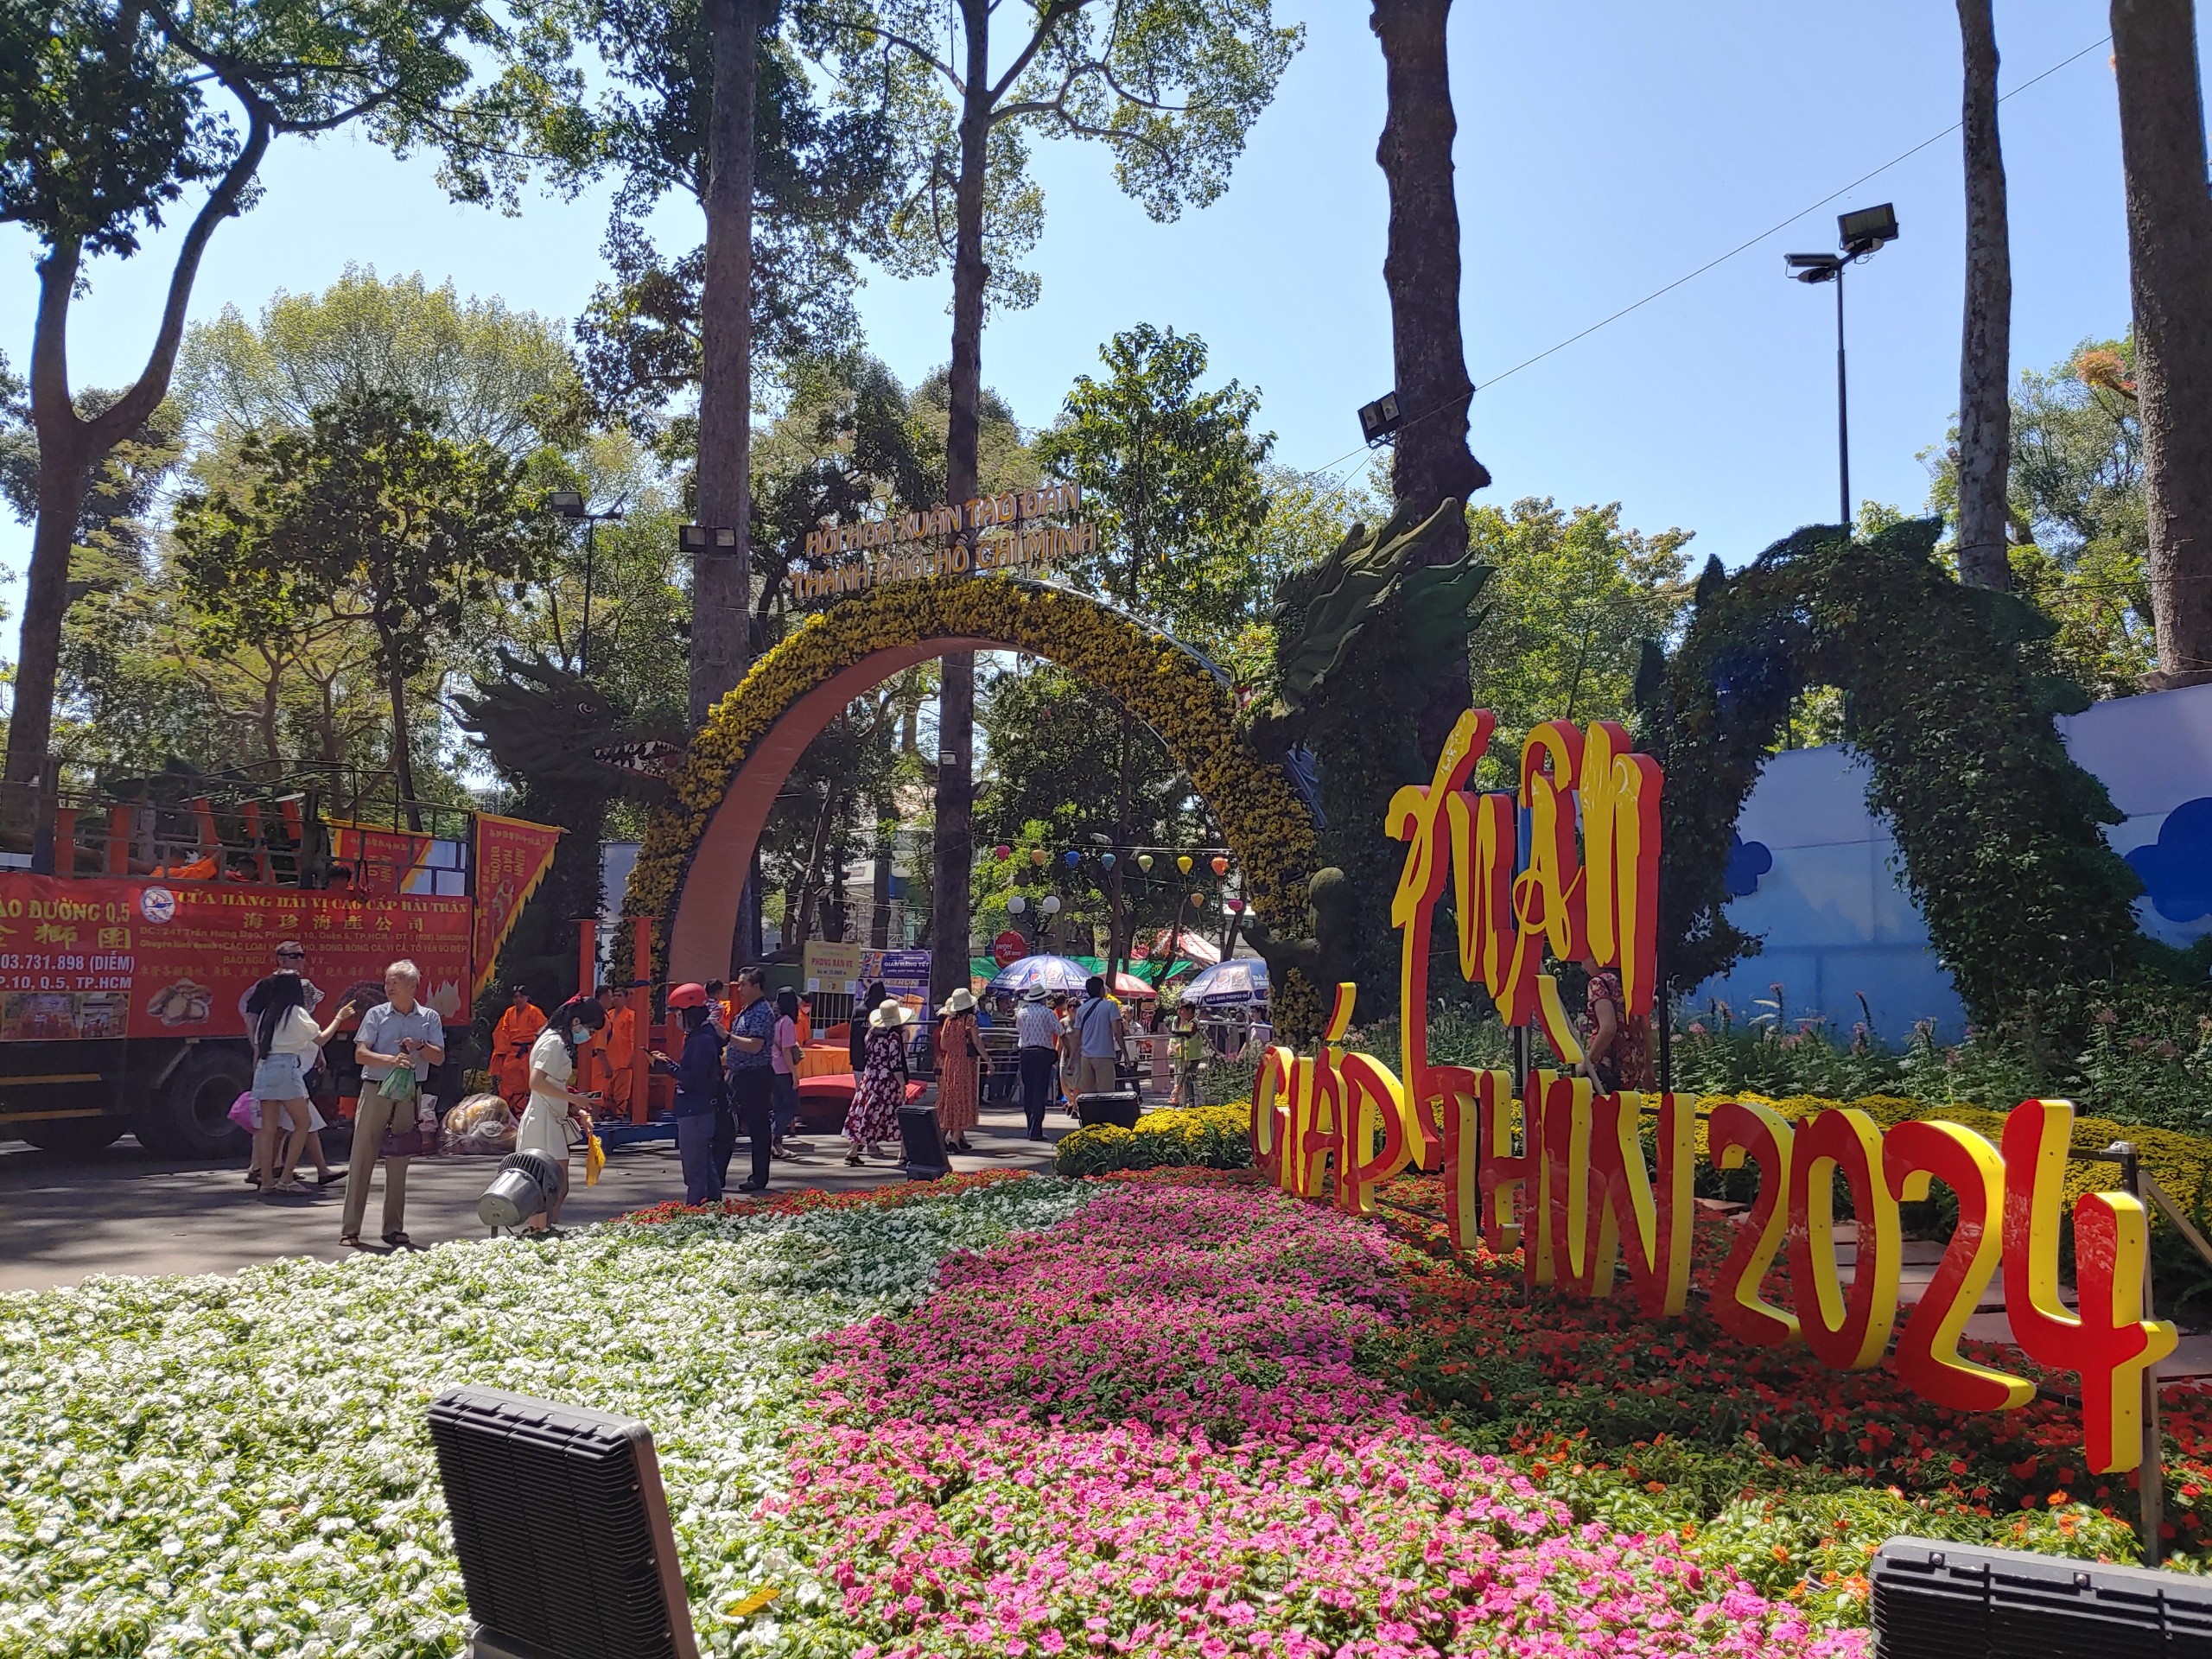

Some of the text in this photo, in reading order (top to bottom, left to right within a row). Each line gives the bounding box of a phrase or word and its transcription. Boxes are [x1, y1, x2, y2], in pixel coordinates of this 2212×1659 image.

[846, 519, 894, 551] HOA
[899, 500, 963, 542] XUÂN
[963, 491, 1017, 529] TAO
[934, 533, 969, 575] HỒ
[1024, 522, 1097, 562] MINH
[28, 896, 101, 922] ĐƯỜNG
[105, 902, 130, 924] Q.5
[177, 887, 216, 905] CỬA
[220, 891, 272, 907] HÀNG
[312, 897, 328, 912] VỊ
[332, 898, 362, 910] CAO
[366, 894, 397, 911] CẤP
[430, 899, 467, 913] TRÂN
[41, 976, 70, 991] Q.5,
[76, 976, 132, 989] TP.HCM
[1250, 982, 1412, 1217] GIÁP
[1707, 1098, 2179, 1475] 2024
